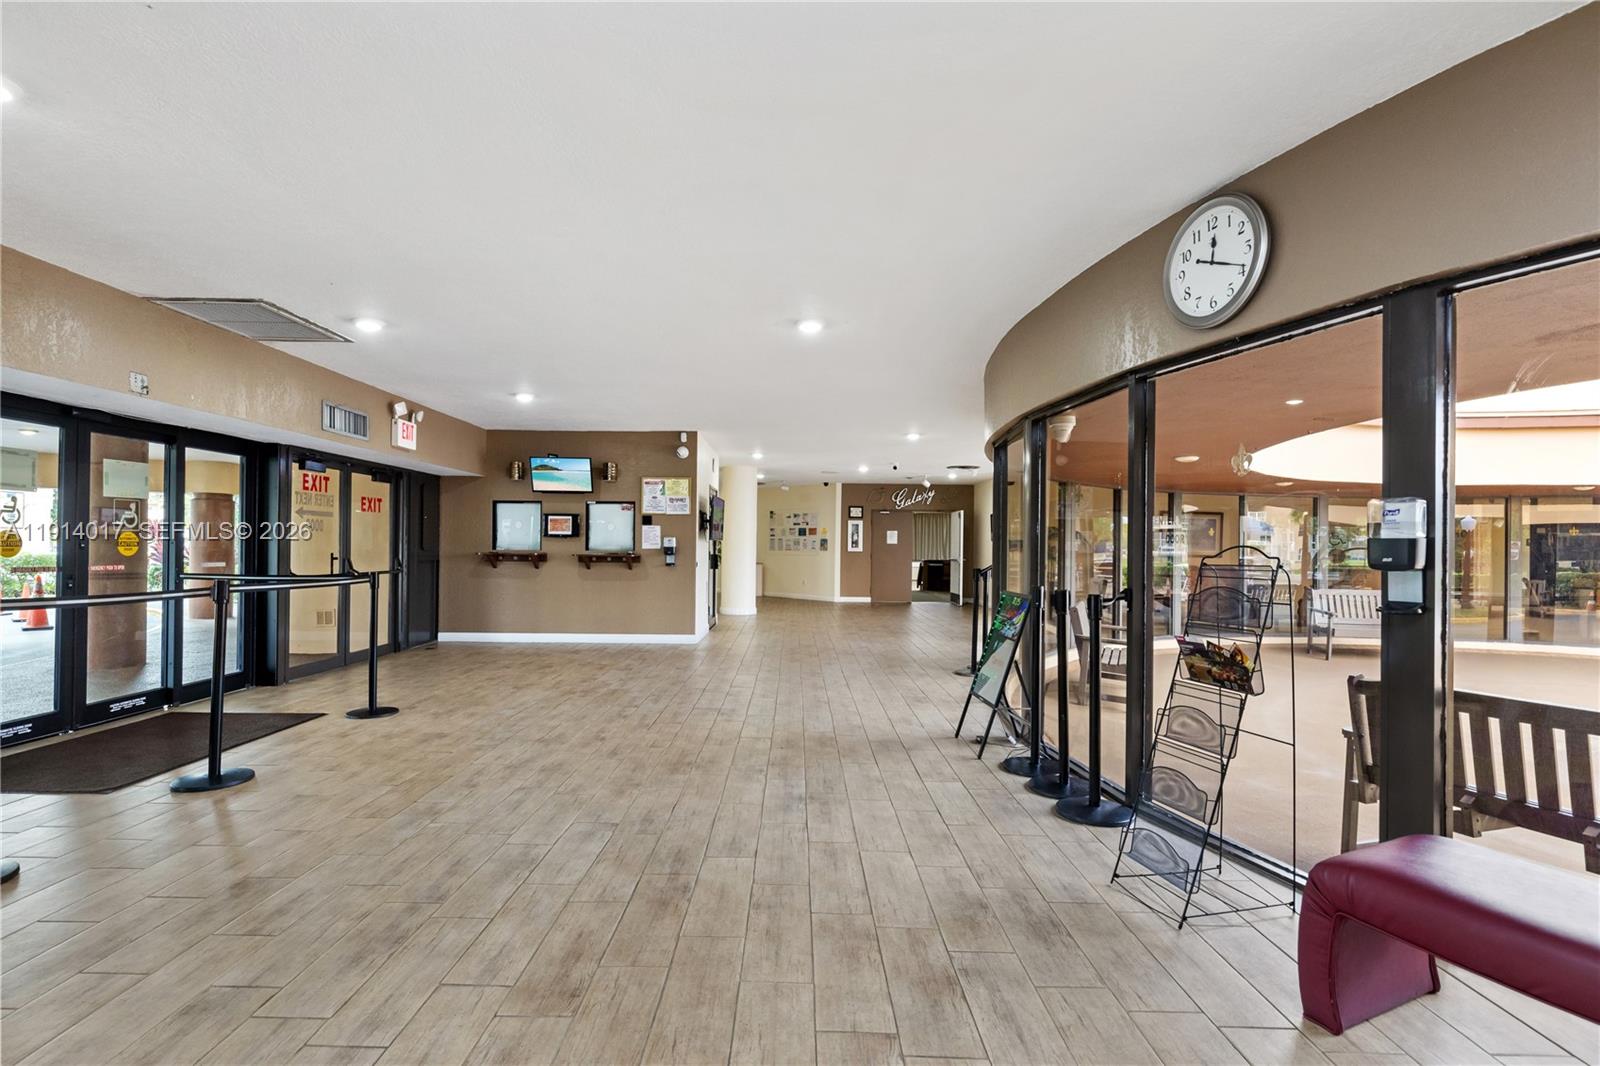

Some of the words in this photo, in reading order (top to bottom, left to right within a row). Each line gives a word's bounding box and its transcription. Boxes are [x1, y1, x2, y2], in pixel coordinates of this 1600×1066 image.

[1207, 216, 1218, 232] 12
[1227, 214, 1231, 227] 1
[1238, 221, 1245, 235] 2
[1192, 230, 1201, 244] 11
[1243, 239, 1252, 255] 3
[1180, 249, 1192, 264] 10
[1178, 270, 1186, 283] 9
[1183, 286, 1191, 301] 8
[1226, 282, 1235, 297] 5
[1195, 296, 1202, 309] 7
[1209, 295, 1218, 309] 6
[402, 422, 414, 441] EXIT
[302, 473, 330, 493] EXIT
[361, 496, 383, 513] EXIT
[891, 487, 935, 510] Galaxy
